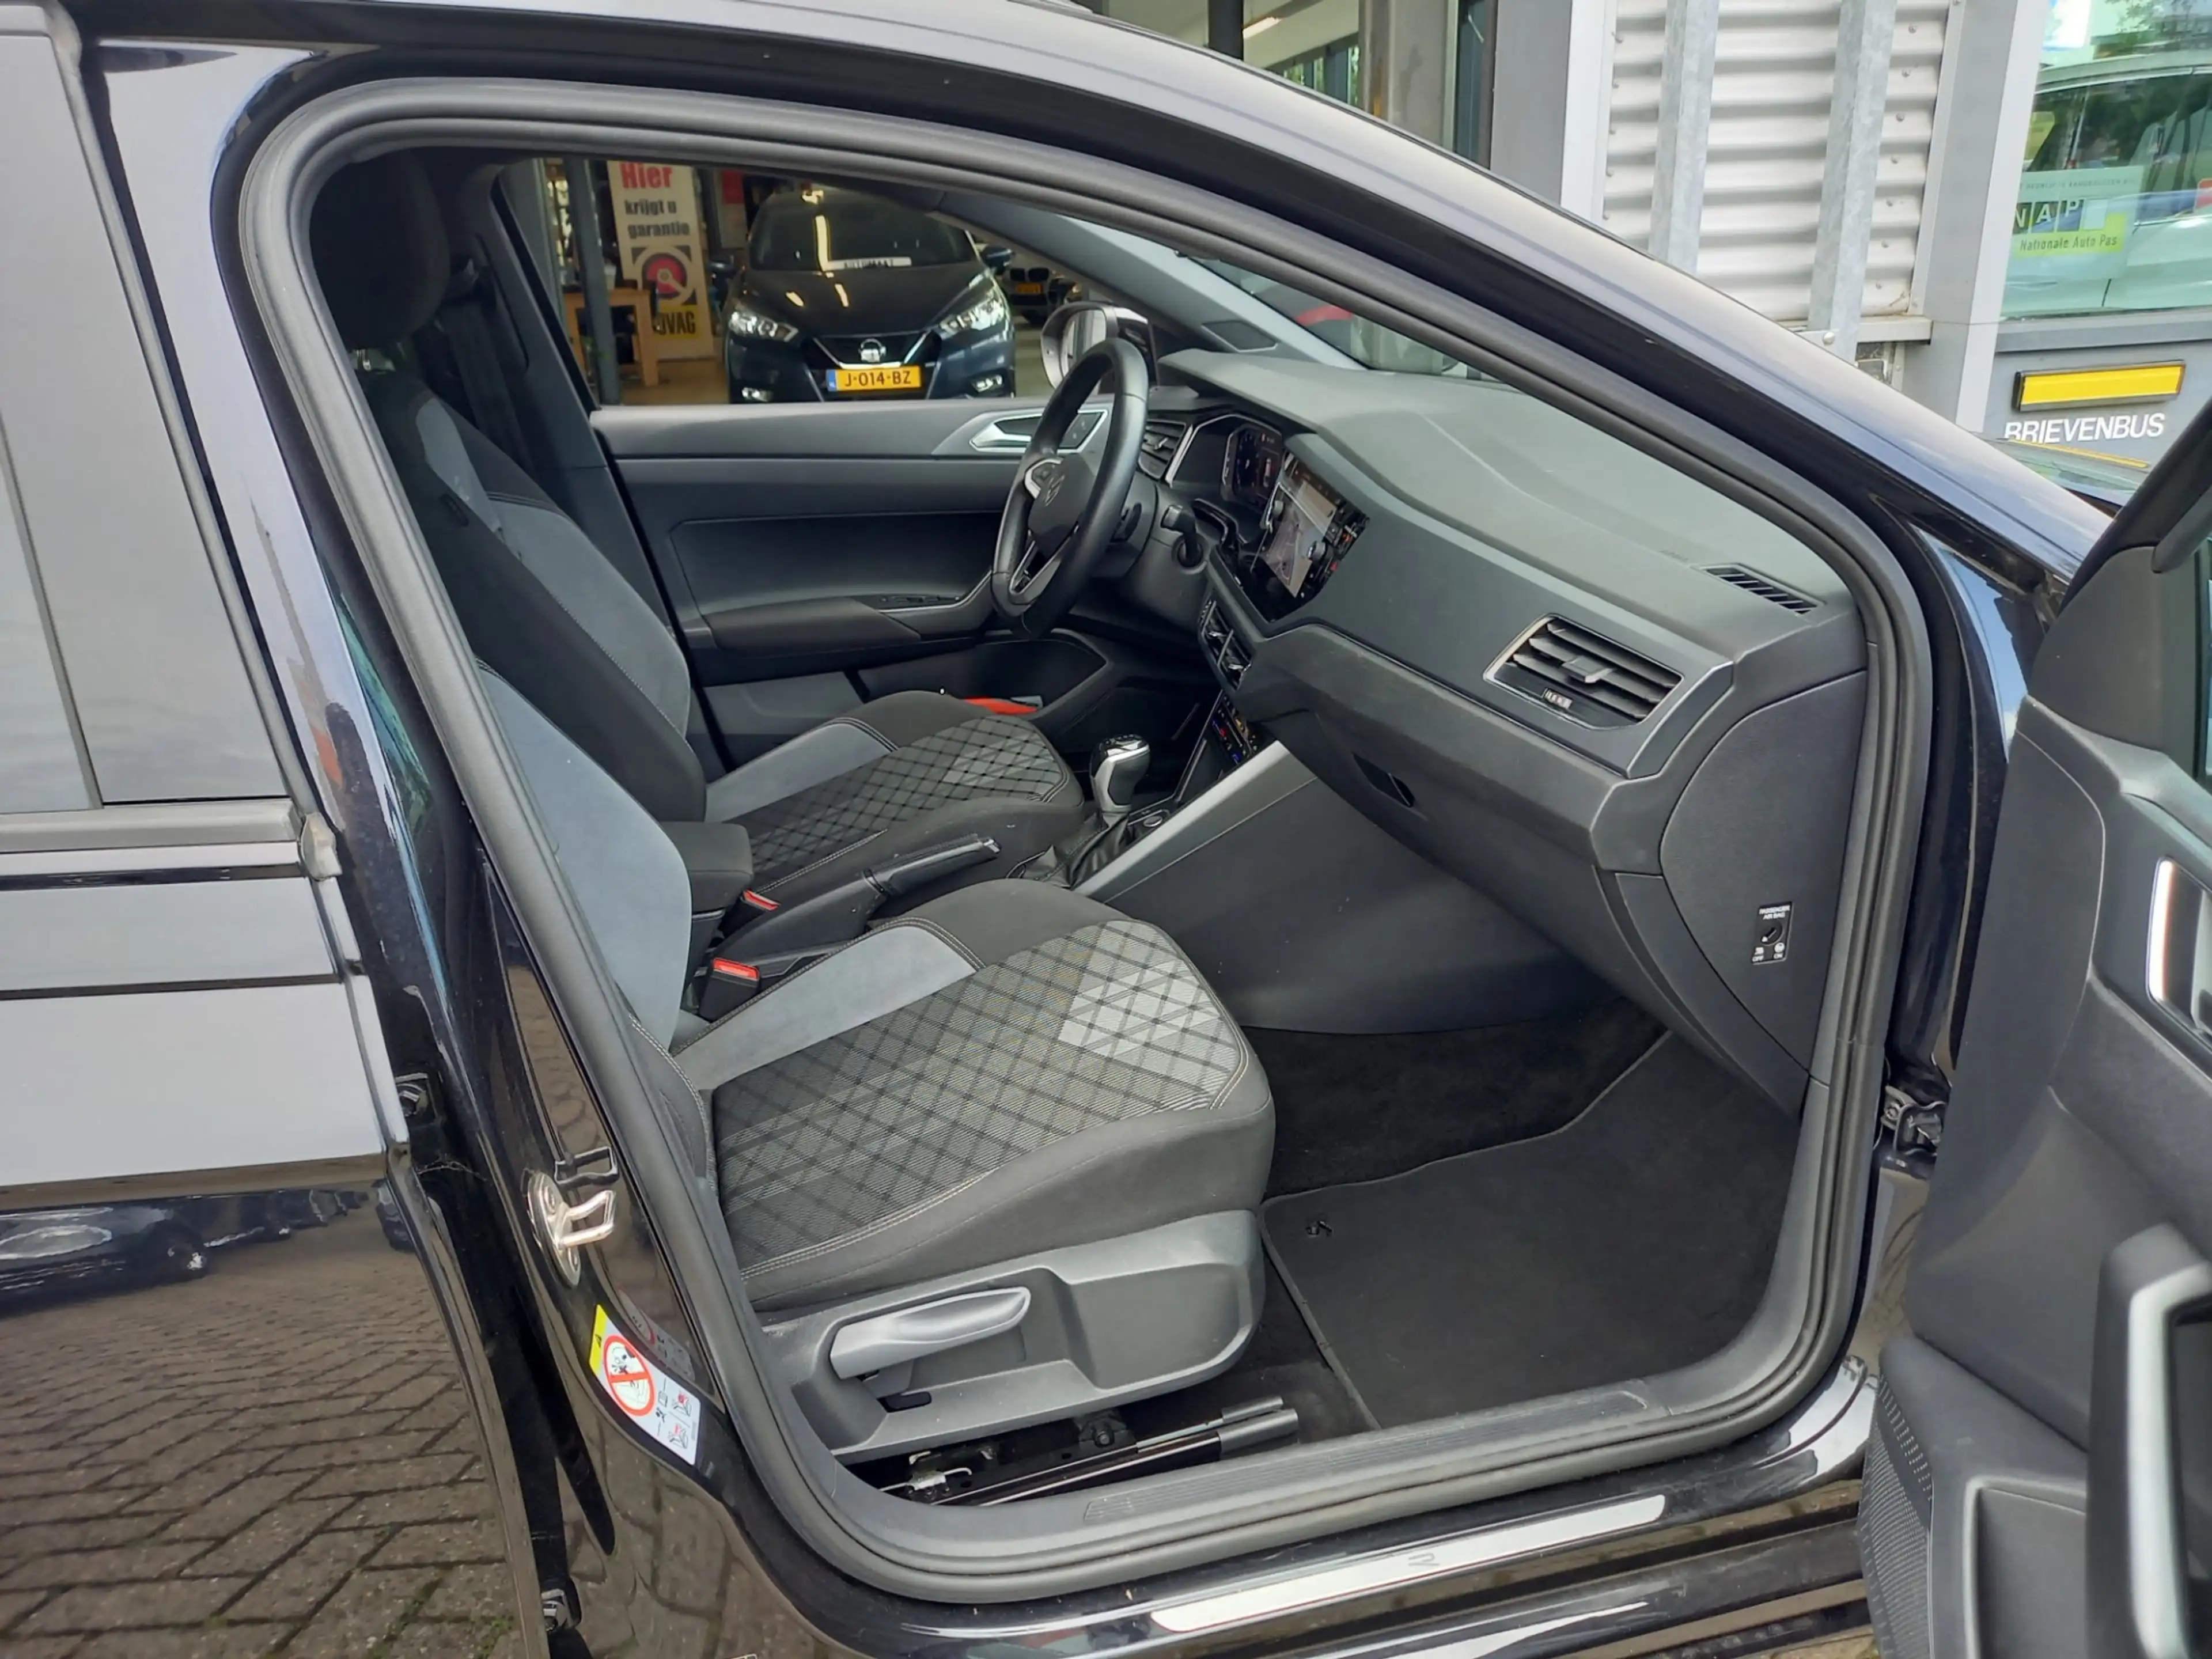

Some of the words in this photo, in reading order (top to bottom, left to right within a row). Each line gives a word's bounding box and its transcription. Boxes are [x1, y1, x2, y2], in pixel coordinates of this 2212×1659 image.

[619, 162, 672, 189] Hier
[624, 200, 664, 215] krijgt
[667, 200, 677, 214] u
[2016, 200, 2080, 228] NAP
[628, 222, 690, 240] garantie
[2020, 237, 2069, 252] Nationale
[2072, 236, 2096, 248] Auto
[2099, 234, 2118, 247] Pas
[844, 370, 911, 387] J-014-BZ
[2004, 412, 2166, 444] BRIEVENBUS
